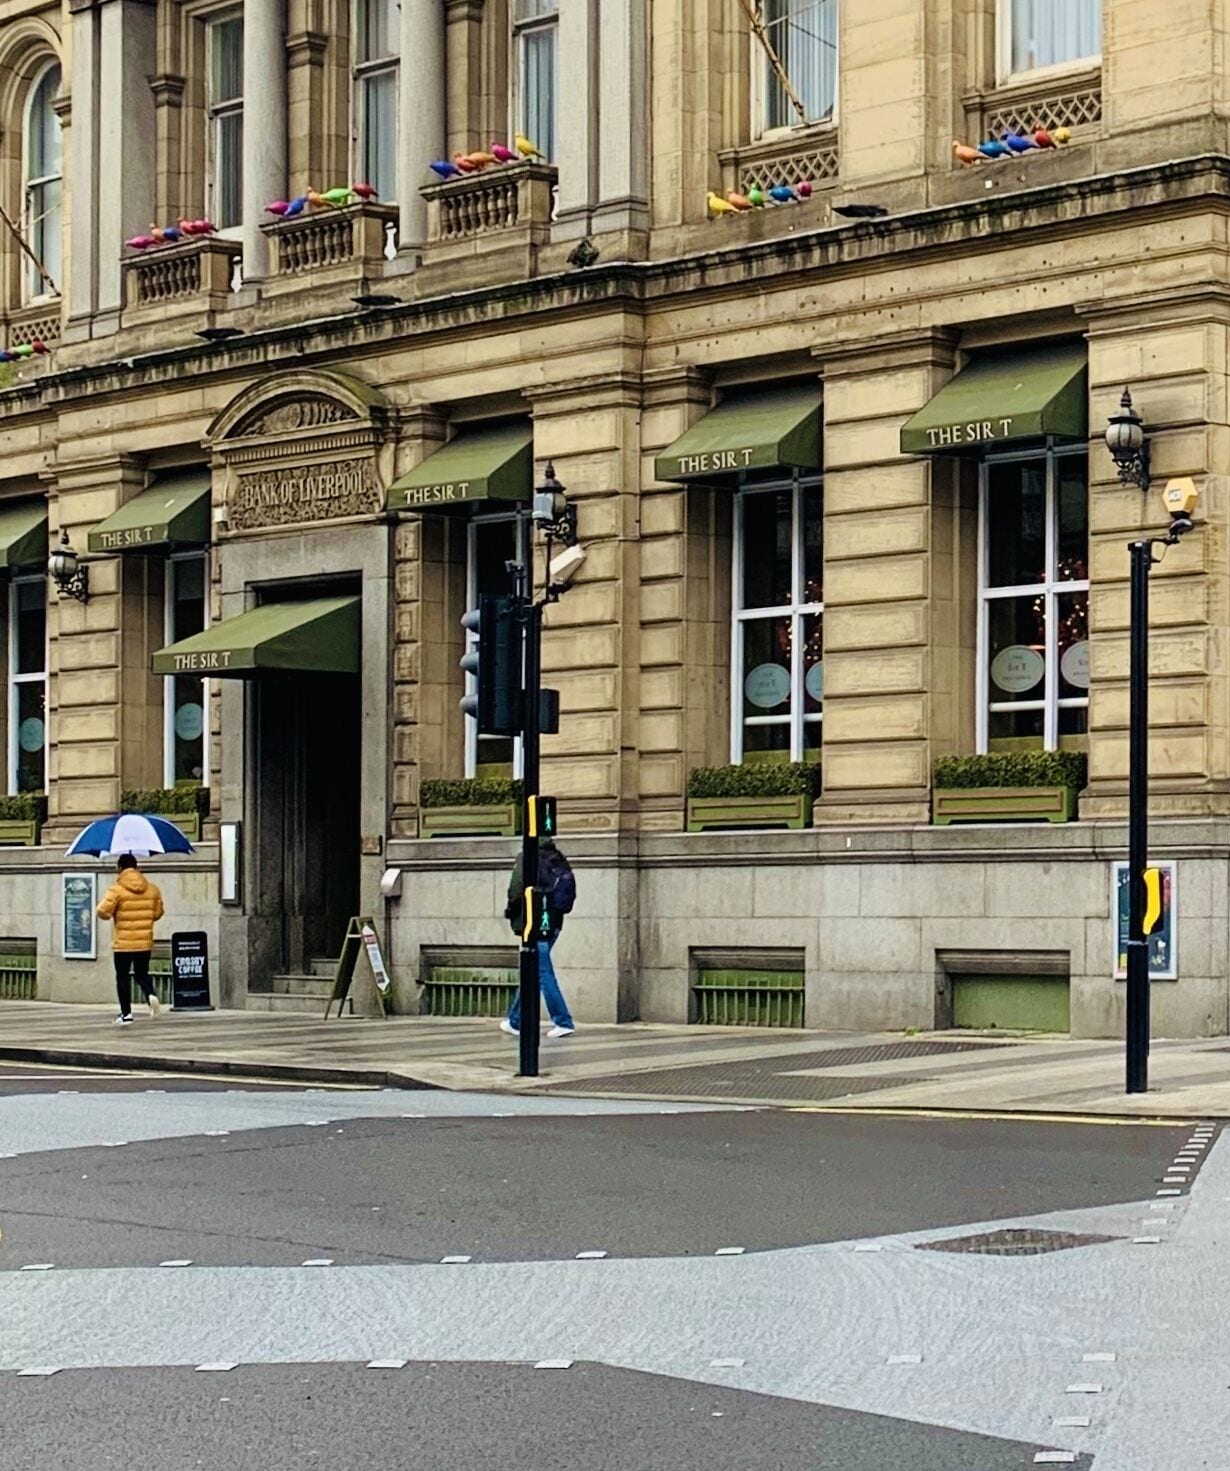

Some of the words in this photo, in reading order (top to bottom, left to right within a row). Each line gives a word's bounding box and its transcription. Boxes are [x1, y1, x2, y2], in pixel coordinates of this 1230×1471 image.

[927, 426, 962, 446] THE
[966, 423, 995, 441] SIR
[999, 419, 1013, 436] T
[678, 454, 708, 474] THE
[712, 451, 737, 470] SIR
[741, 449, 753, 467] T
[245, 481, 279, 509] BANK
[280, 479, 297, 504] OF
[300, 471, 367, 502] LIVERPOOL
[404, 486, 432, 504] THE
[433, 484, 457, 502] SIR
[458, 482, 470, 498] T
[101, 532, 123, 547] THE
[124, 530, 142, 545] SIR
[143, 527, 153, 541] T
[174, 655, 198, 670] THE
[200, 653, 219, 668] SIR
[222, 651, 232, 667] T
[178, 965, 203, 974] COFFEE
